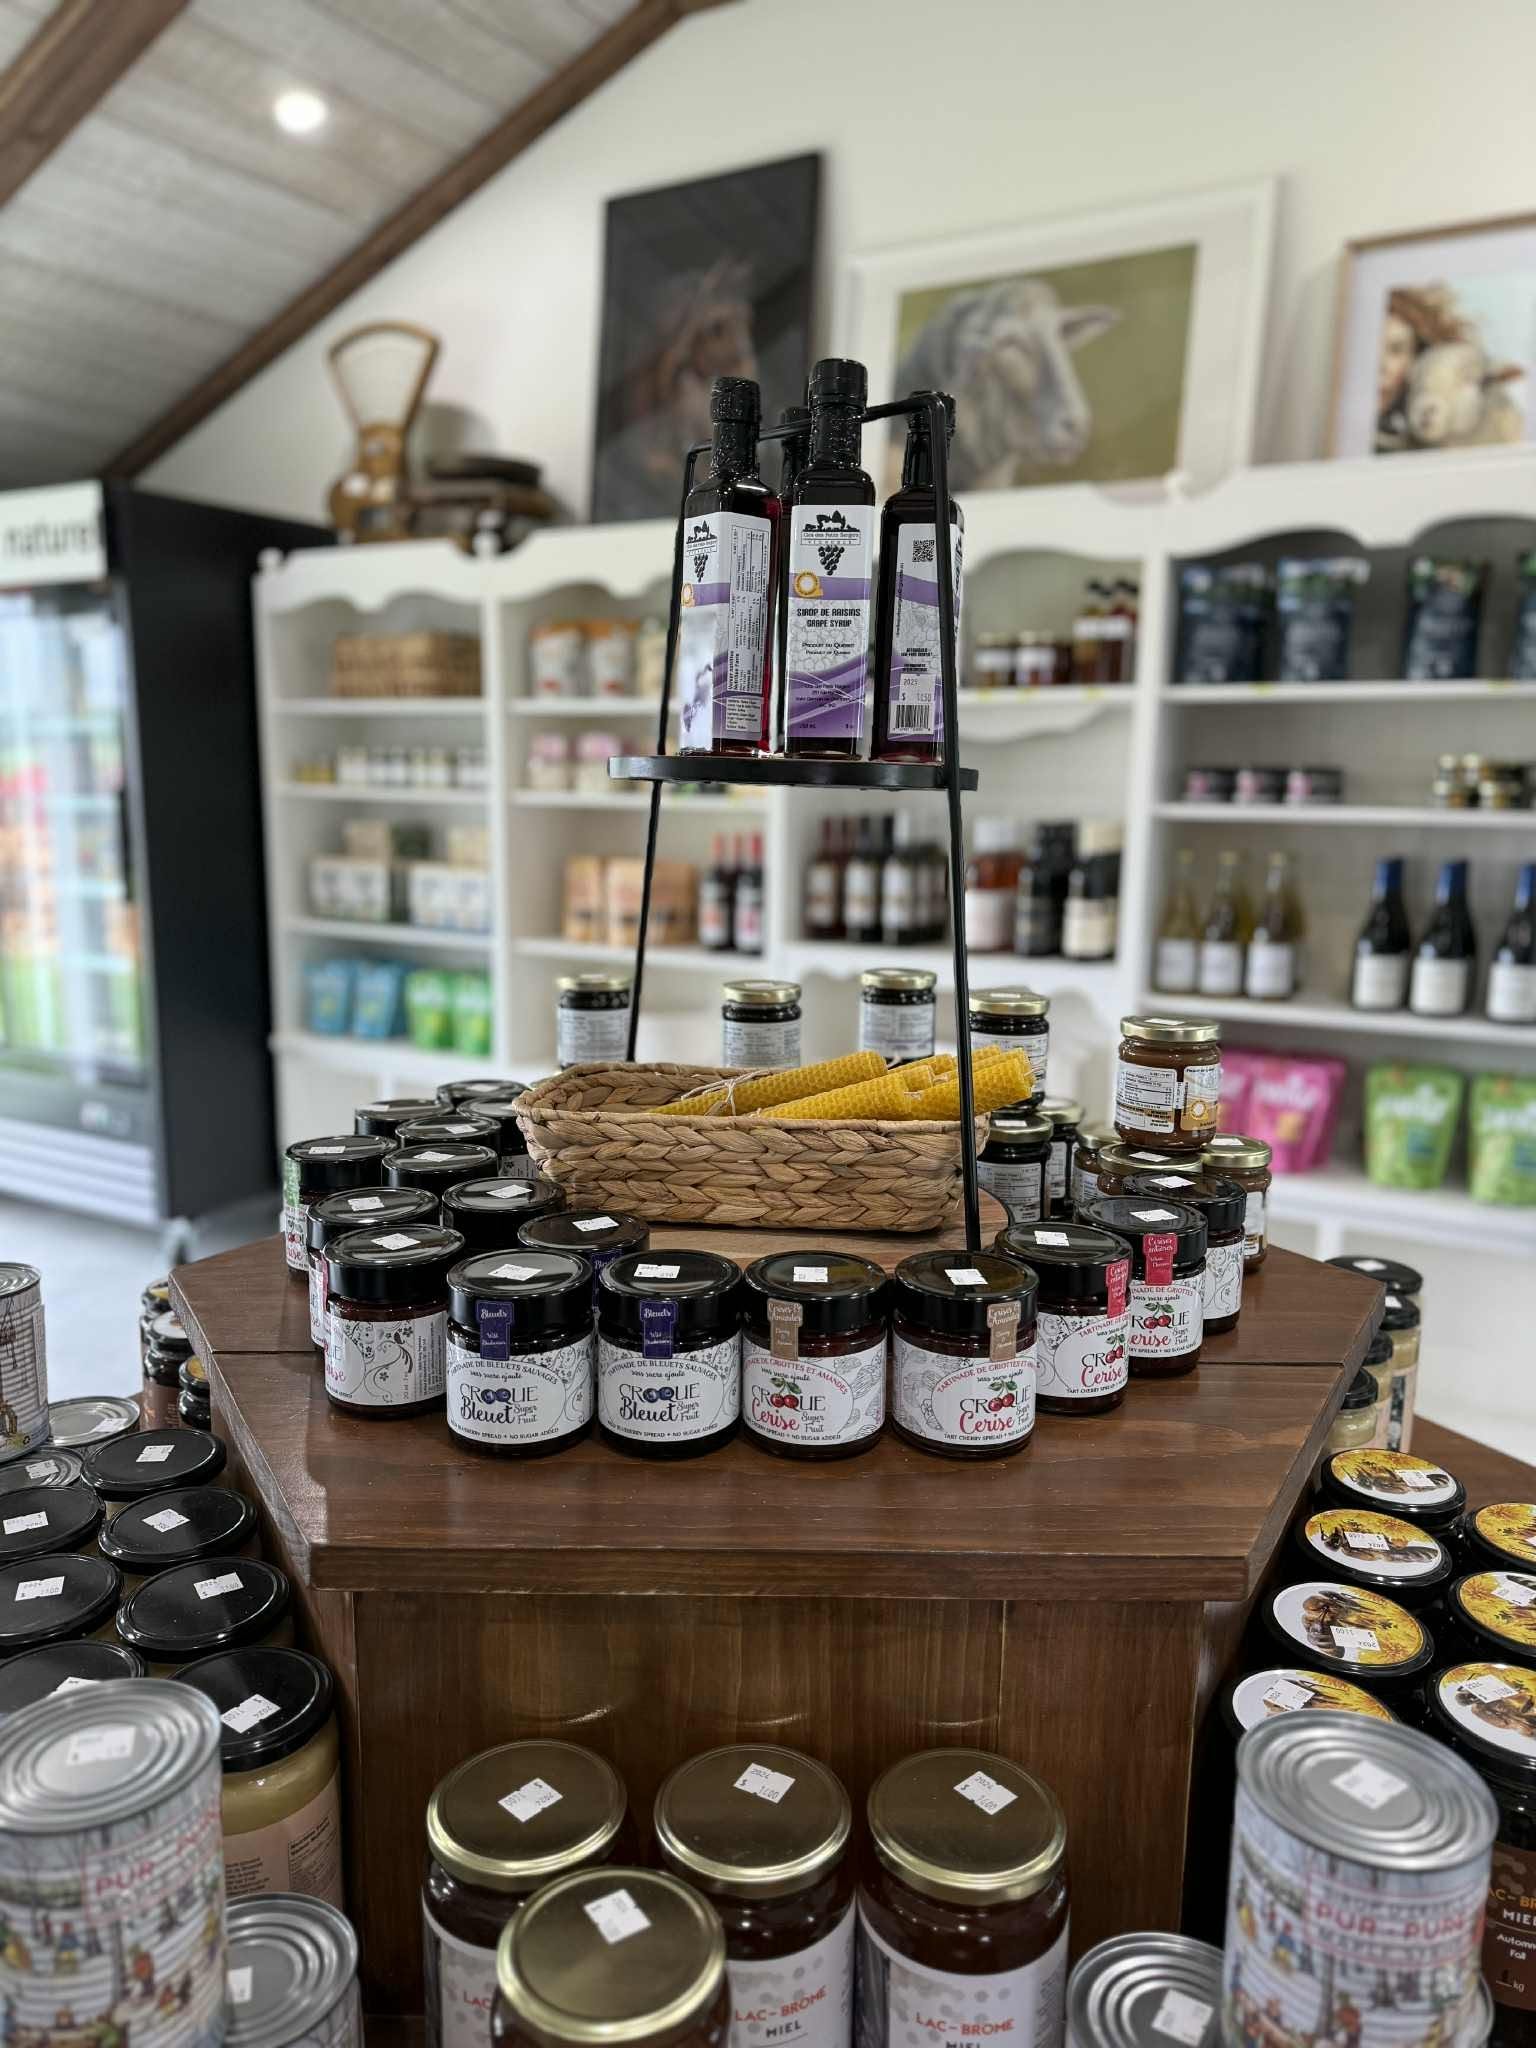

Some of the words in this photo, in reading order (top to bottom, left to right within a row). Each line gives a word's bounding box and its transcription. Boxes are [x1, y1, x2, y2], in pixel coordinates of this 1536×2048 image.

[796, 608, 819, 617] SIROP
[820, 608, 830, 617] DE
[831, 608, 861, 617] RAISINS
[806, 619, 828, 628] GRAPE
[829, 619, 852, 628] SYRUP
[480, 1308, 508, 1320] Bleuets
[643, 1307, 672, 1319] Bleuets
[1131, 1310, 1191, 1330] ROQUE
[1078, 1319, 1115, 1338] TARTINADE
[1129, 1330, 1172, 1347] erise
[475, 1360, 485, 1368] DE
[486, 1361, 521, 1371] BLEUETS
[522, 1365, 558, 1385] SAUVAGES
[637, 1359, 648, 1367] DE
[649, 1359, 684, 1370] BLEUETS
[684, 1362, 718, 1381] SAUVAGES
[1080, 1364, 1123, 1389] Cerise
[805, 1365, 817, 1375] ET
[817, 1370, 849, 1395] AMANDES
[936, 1369, 976, 1393] TARTINADE
[976, 1365, 987, 1374] DE
[987, 1361, 1021, 1373] GRIOTTES
[460, 1396, 516, 1425] Bleuet
[513, 1404, 537, 1416] Super
[619, 1395, 680, 1422] Bleuet
[677, 1401, 701, 1414] Super
[751, 1396, 800, 1431] Cerise
[517, 1413, 538, 1425] Fruit
[679, 1411, 701, 1422] Fruit
[800, 1411, 825, 1423] Super
[959, 1410, 1016, 1435] Cerise
[481, 1431, 502, 1440] SPREAD
[519, 1431, 540, 1439] SUGAR
[540, 1427, 560, 1437] ADDED
[643, 1430, 666, 1438] SPREAD
[804, 1422, 825, 1433] Fruit
[738, 1778, 748, 1787] $
[960, 1783, 970, 1792] $
[1509, 1948, 1527, 1961] Fall
[1512, 1980, 1525, 1992] kg
[765, 2020, 803, 2038] MIEL
